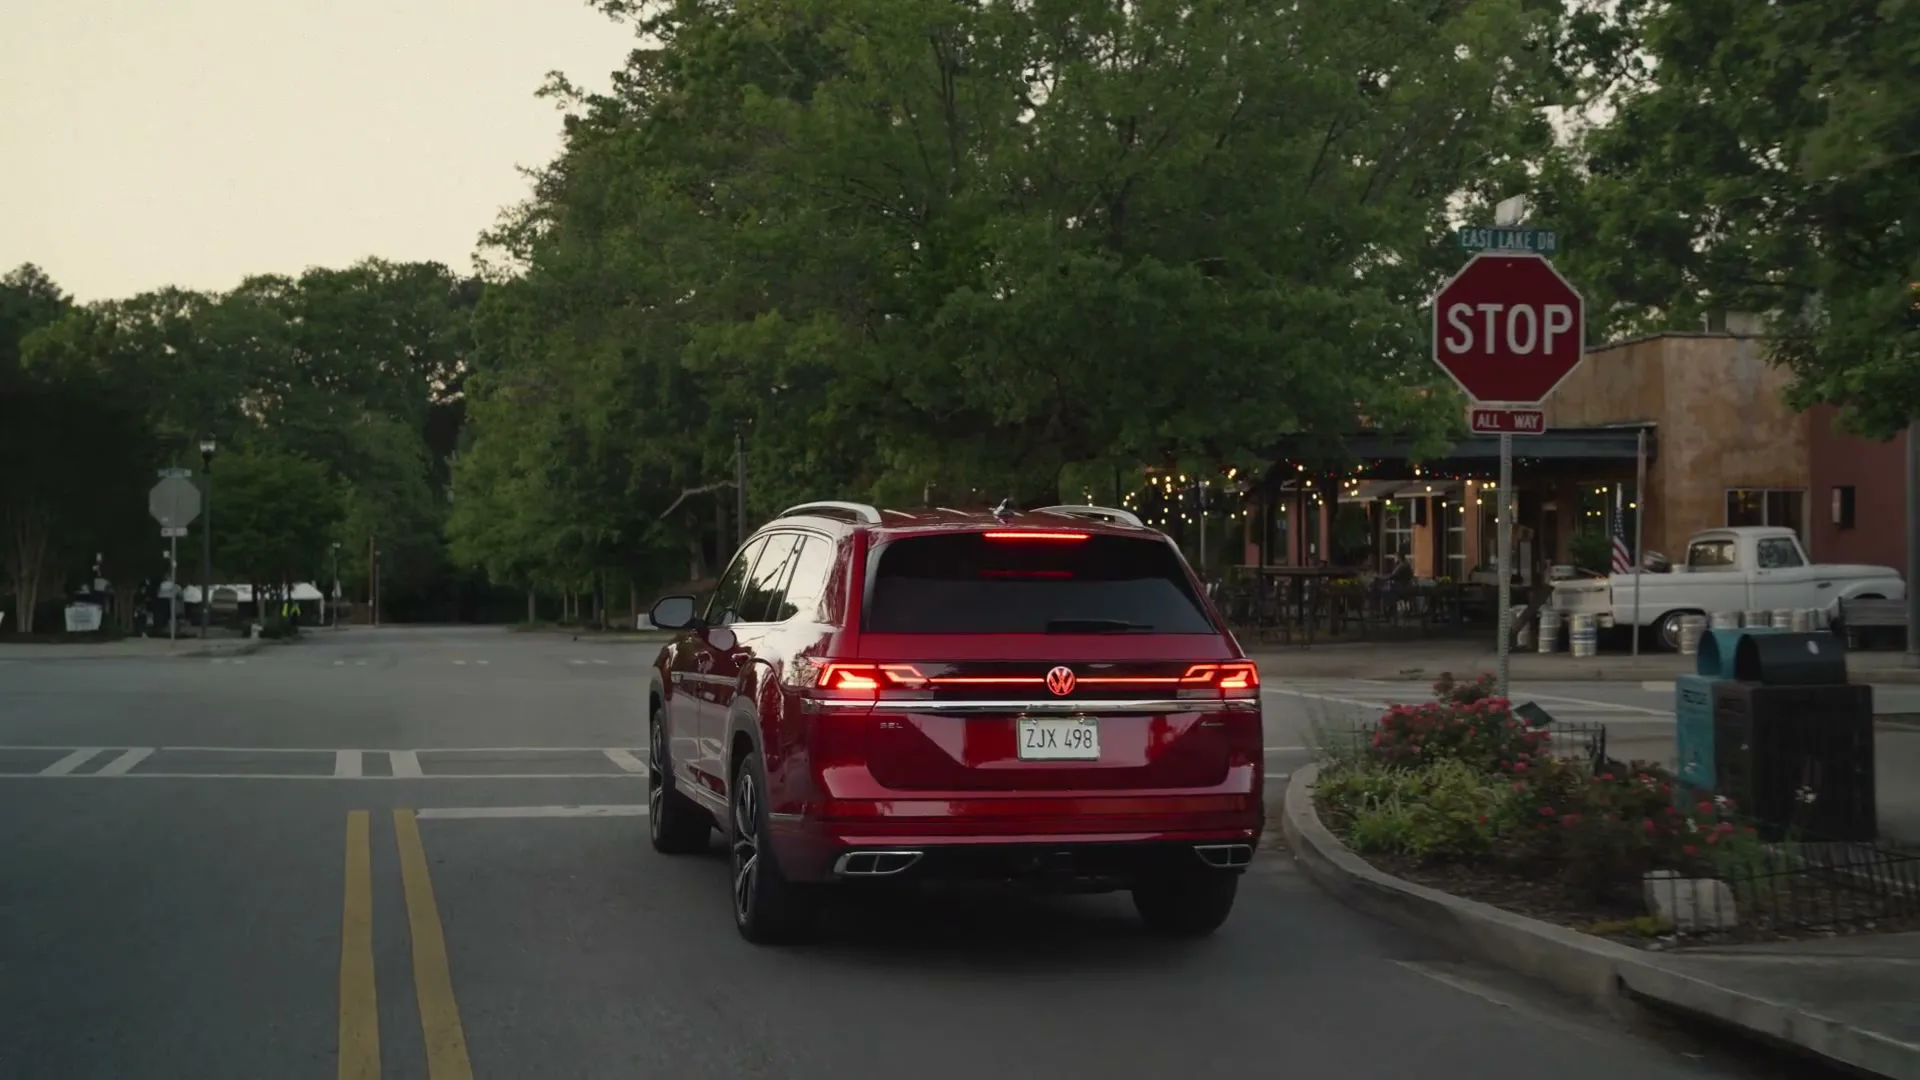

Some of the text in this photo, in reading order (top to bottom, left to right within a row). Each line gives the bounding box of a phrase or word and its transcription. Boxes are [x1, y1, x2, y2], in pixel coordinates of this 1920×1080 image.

[1461, 228, 1556, 250] EAST LAKE DR
[1444, 302, 1573, 355] STOP
[1476, 413, 1540, 429] ALL WAY
[1026, 728, 1093, 749] ZJX 498
